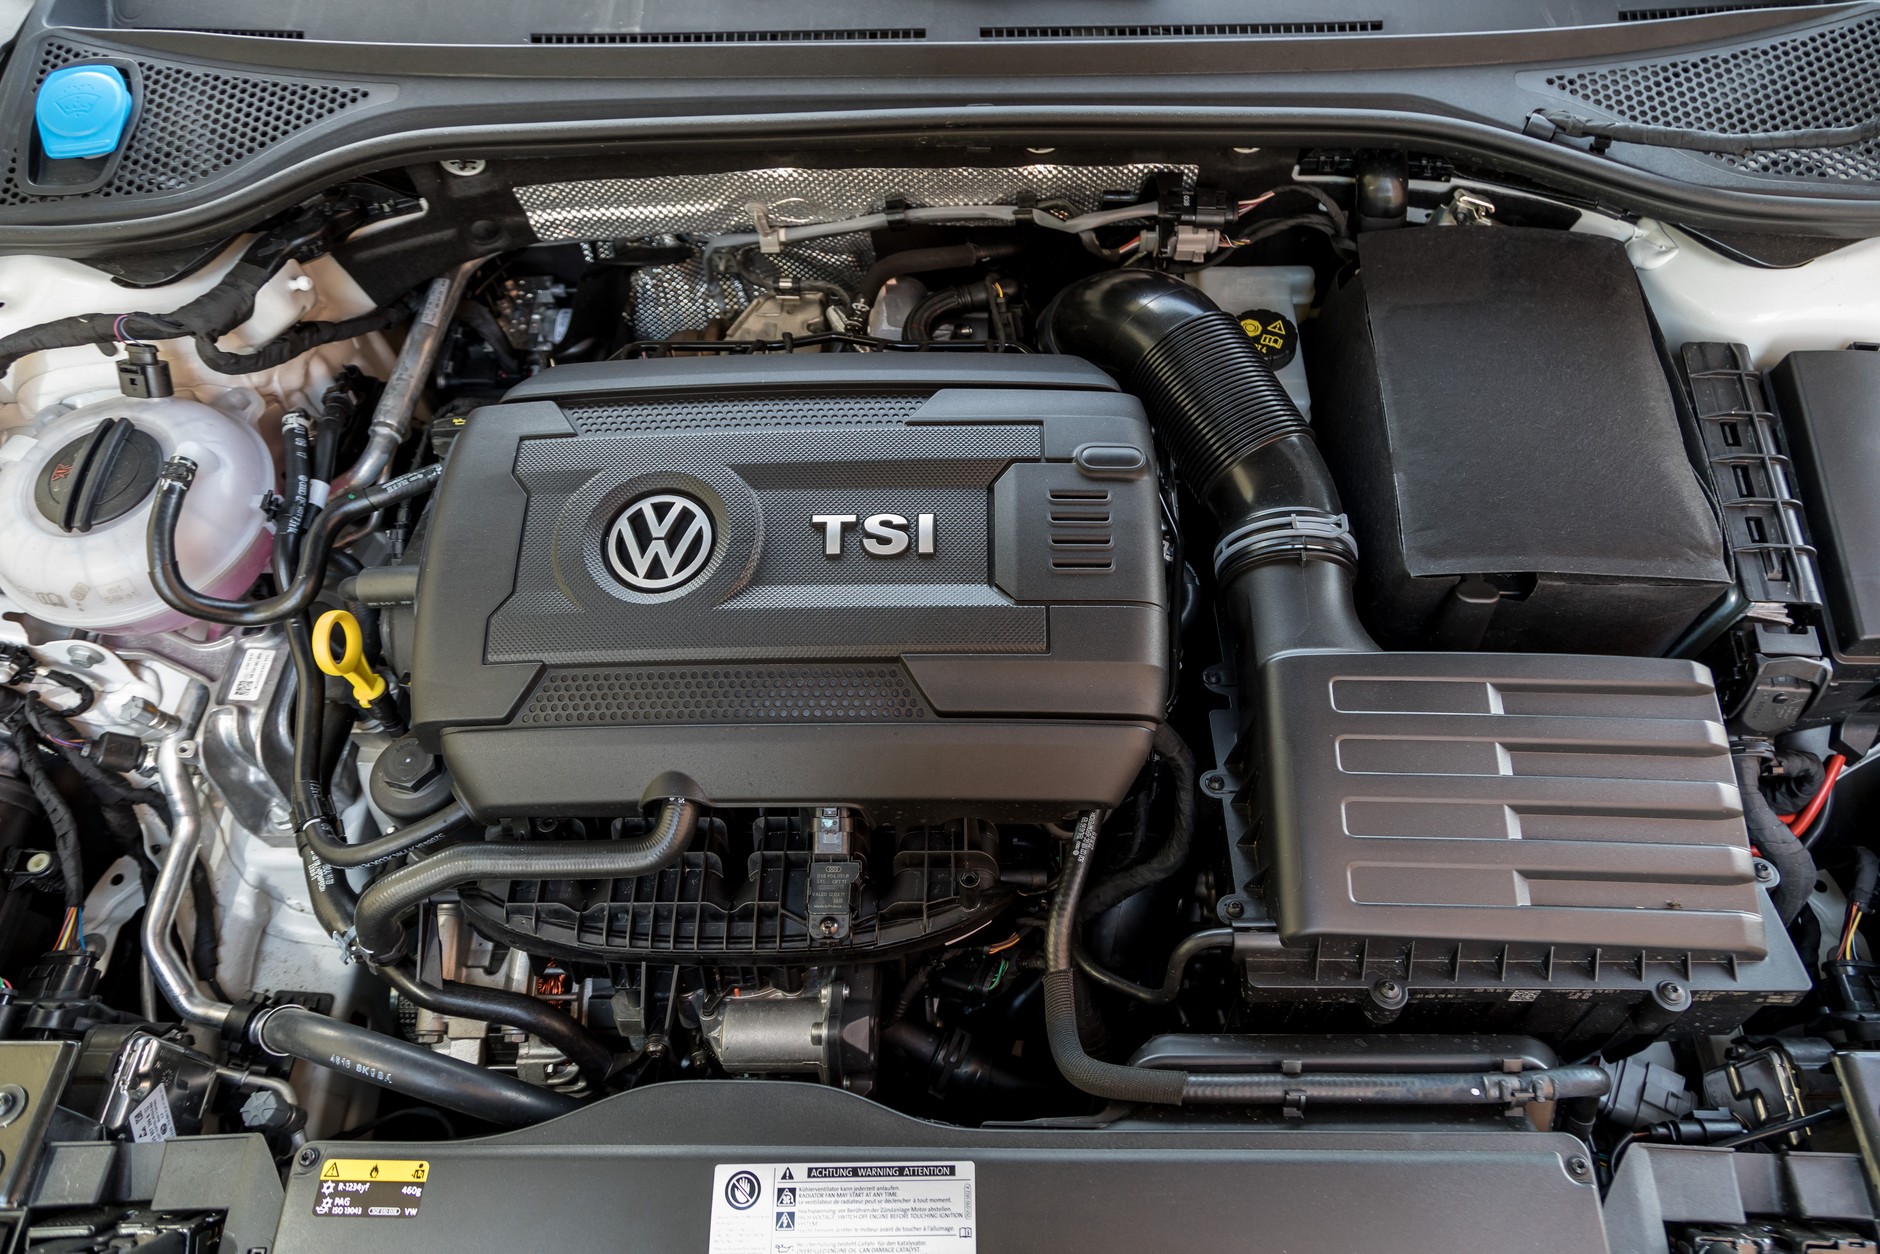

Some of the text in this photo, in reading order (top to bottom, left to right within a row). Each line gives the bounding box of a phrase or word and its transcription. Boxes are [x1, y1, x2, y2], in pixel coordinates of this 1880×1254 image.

[811, 513, 937, 557] TSI
[810, 1166, 950, 1177] ACHTUNG WARNING ATTENTION
[338, 1183, 422, 1197] R-1234yf 460g
[334, 1197, 350, 1206] PAG
